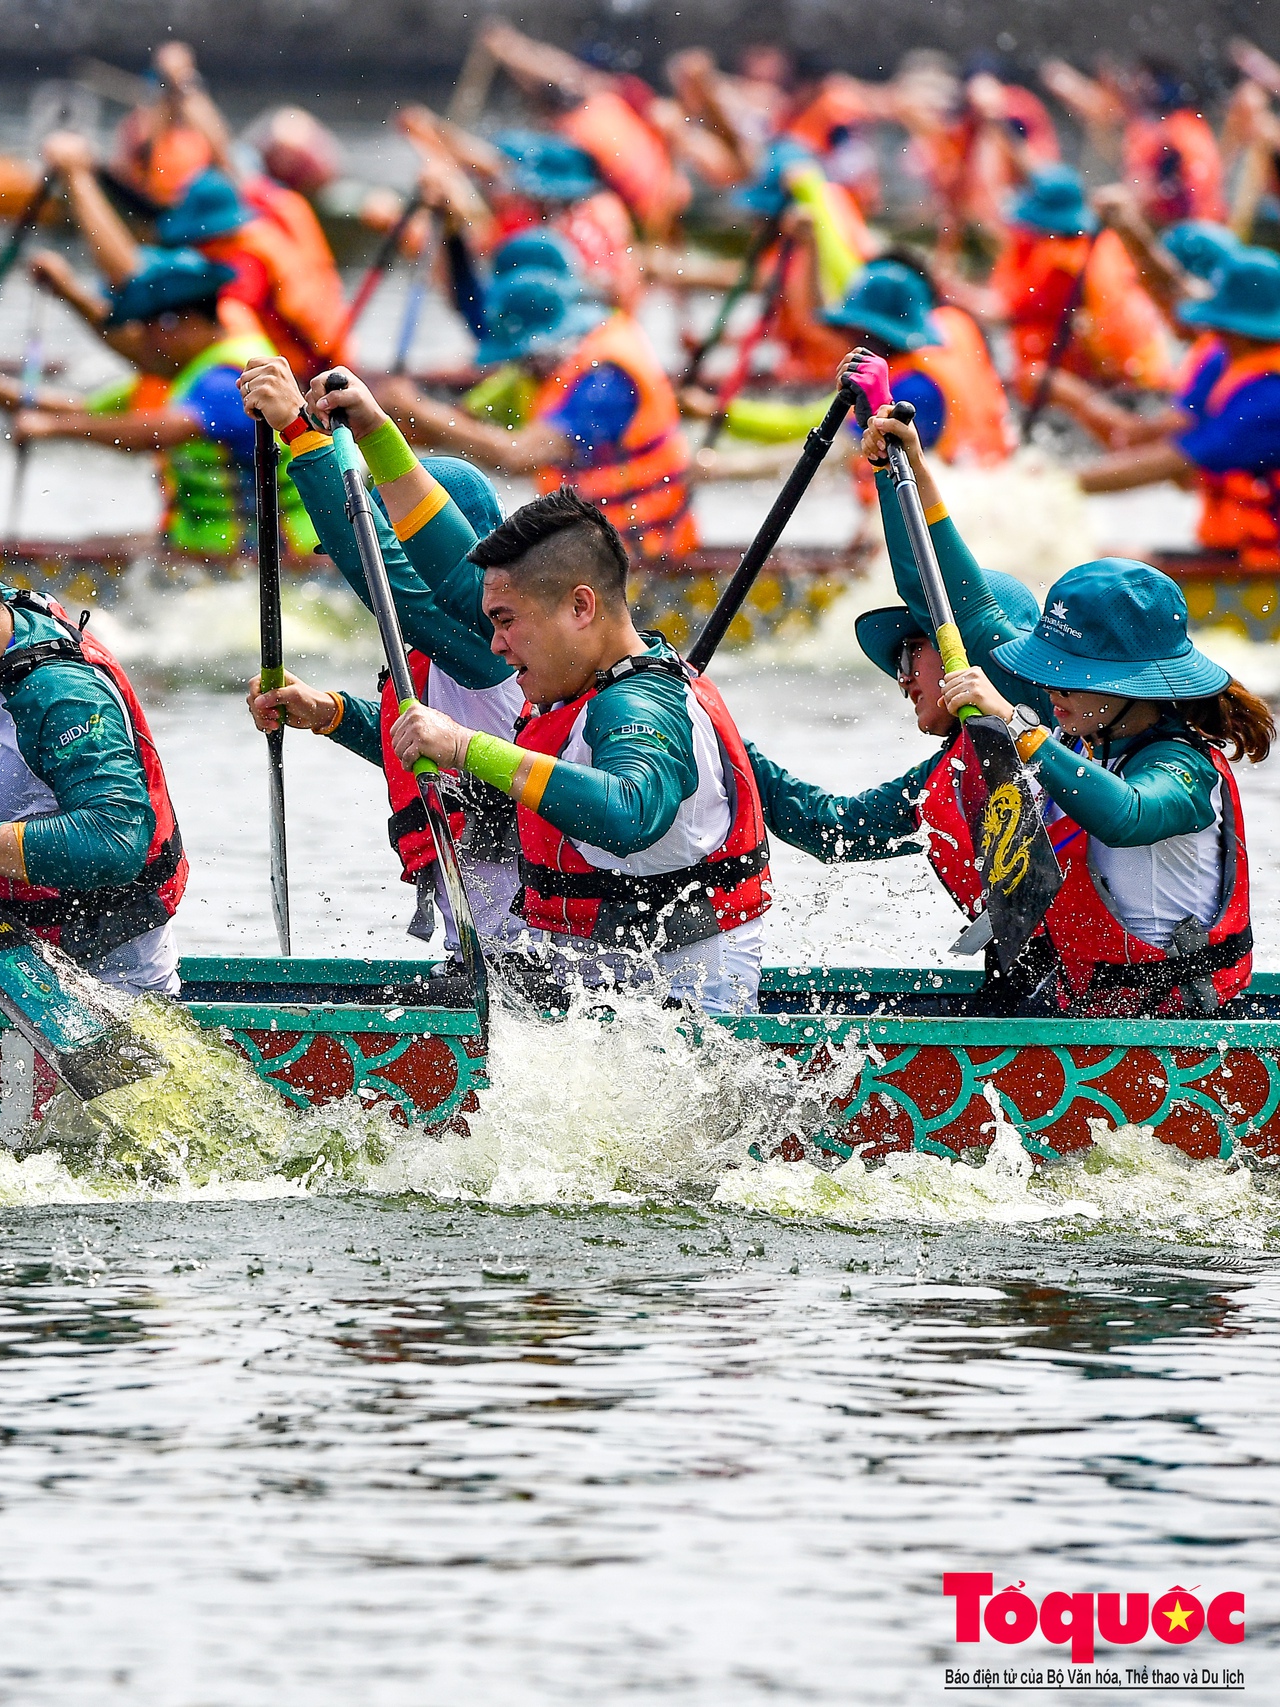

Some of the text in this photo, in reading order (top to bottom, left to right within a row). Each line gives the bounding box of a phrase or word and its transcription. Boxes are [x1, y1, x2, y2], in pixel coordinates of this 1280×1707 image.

[59, 720, 89, 746] BIDV
[621, 723, 655, 735] BIDV
[17, 961, 45, 984] BIDV
